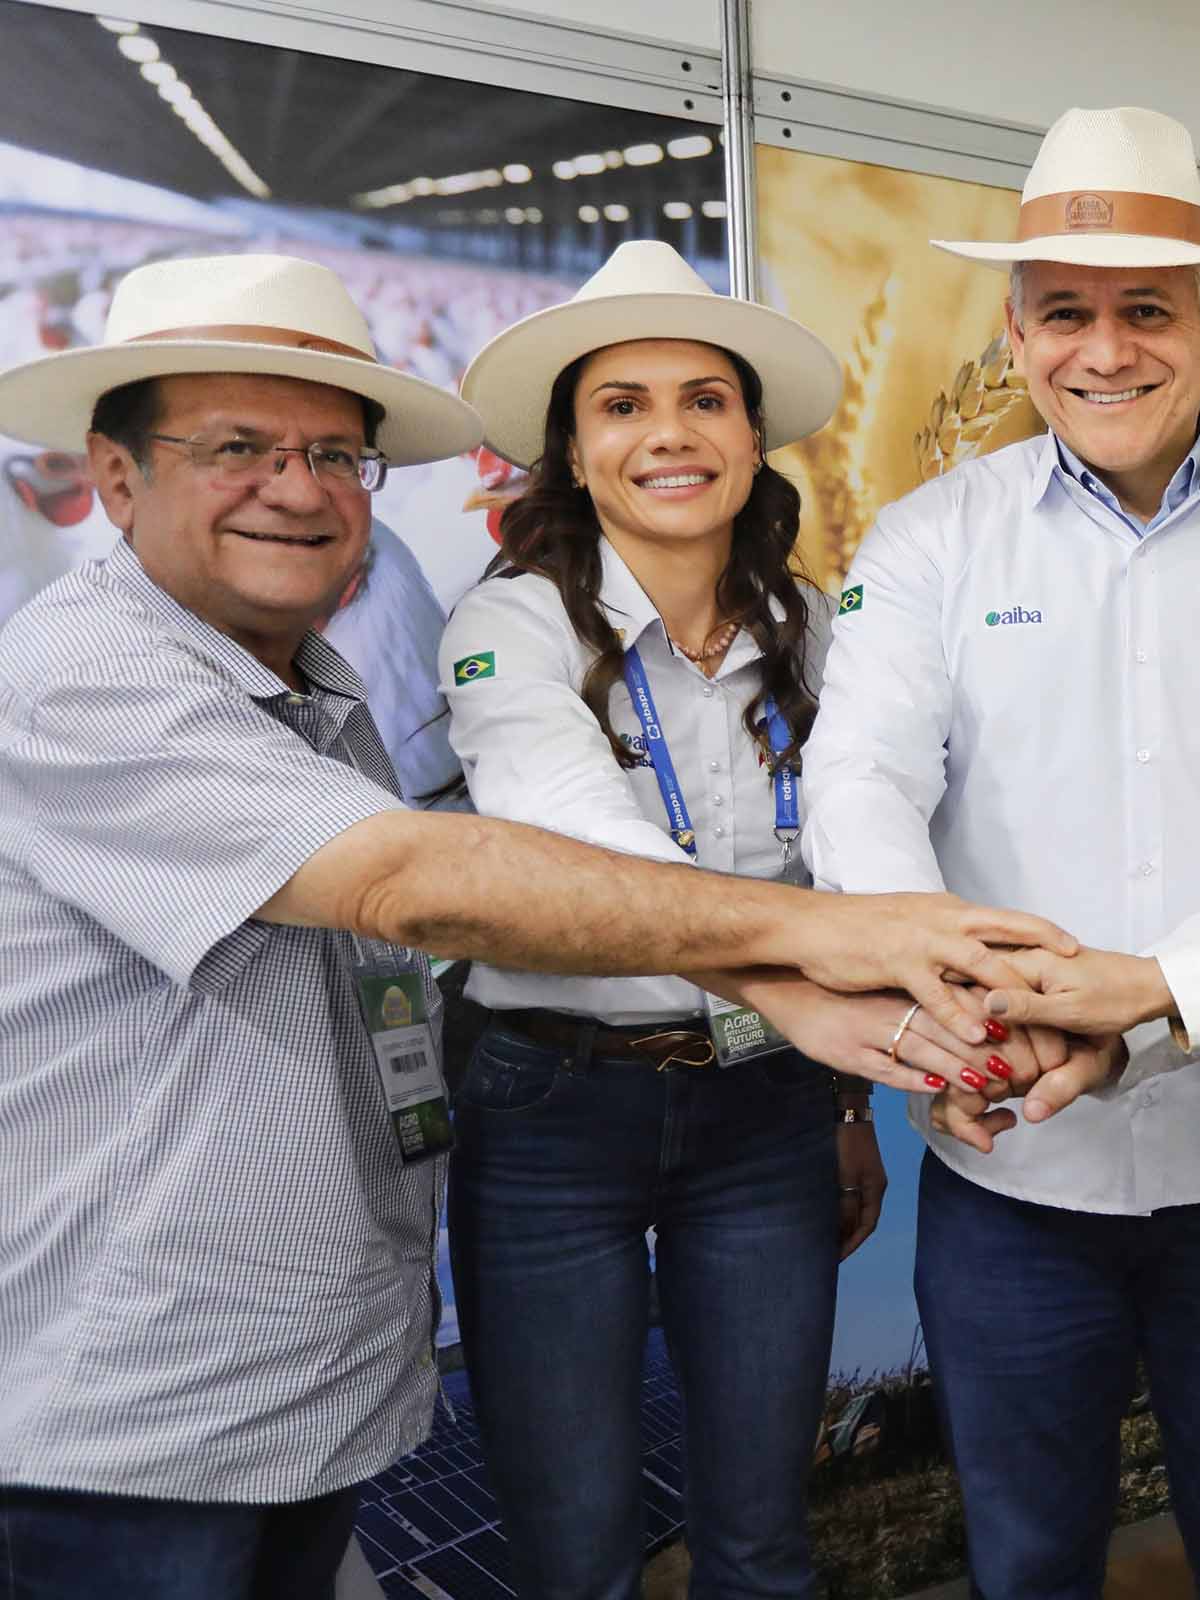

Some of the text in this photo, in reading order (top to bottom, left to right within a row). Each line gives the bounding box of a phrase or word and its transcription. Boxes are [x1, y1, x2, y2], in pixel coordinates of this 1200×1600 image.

[1001, 606, 1042, 624] aiba
[637, 687, 655, 723] abapa
[670, 793, 686, 829] abapa
[724, 1012, 760, 1032] AGRO
[728, 1029, 764, 1047] FUTURO
